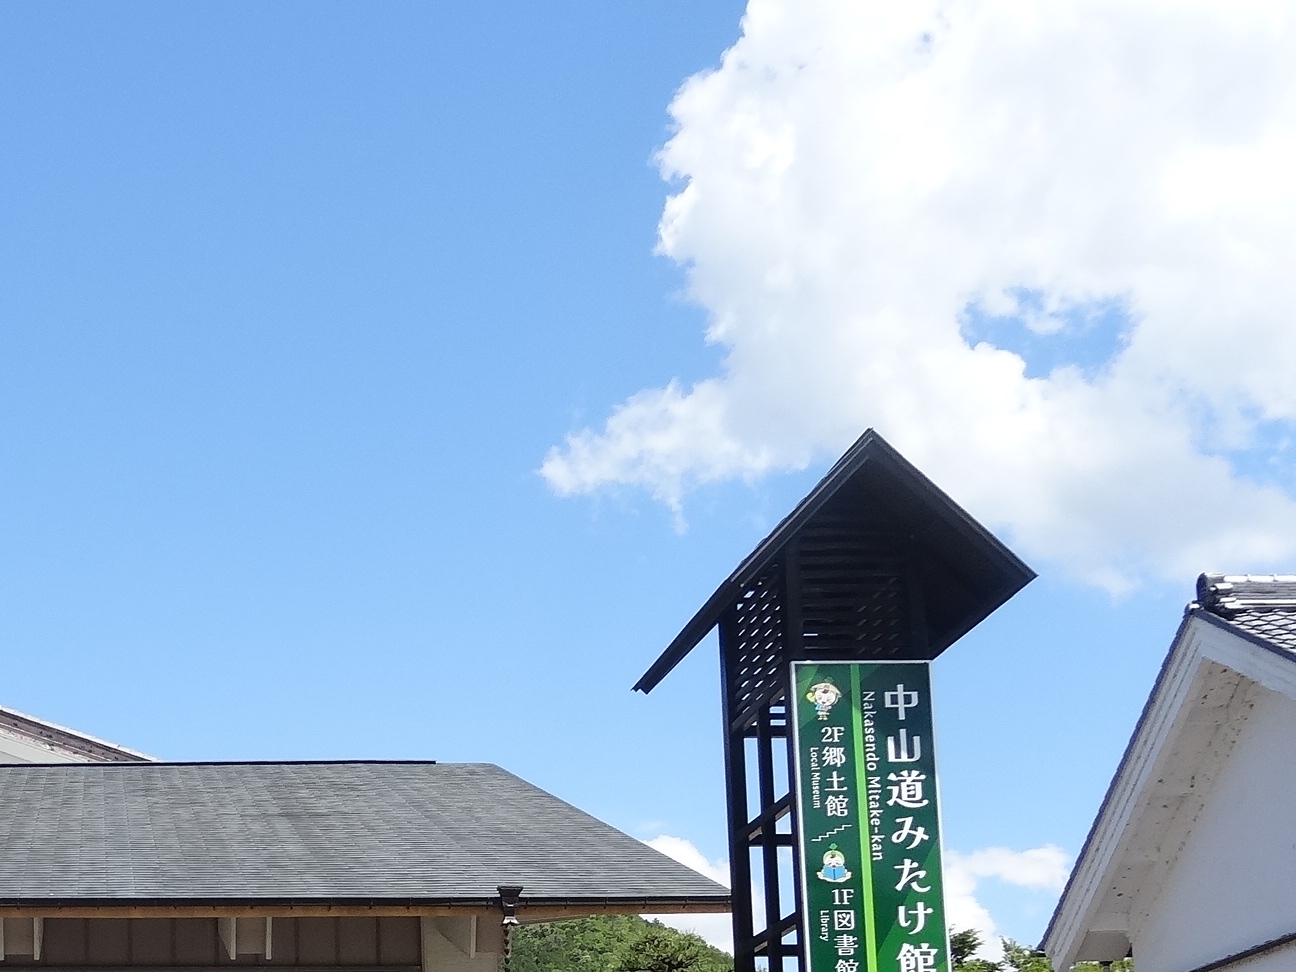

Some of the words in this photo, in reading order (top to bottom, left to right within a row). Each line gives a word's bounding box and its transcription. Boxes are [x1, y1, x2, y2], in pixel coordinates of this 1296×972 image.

[810, 747, 820, 771] Local
[862, 690, 877, 771] Nakasendo
[811, 772, 821, 809] Museum
[821, 726, 849, 817] 2F郷土館
[867, 776, 883, 861] Mitake-kan
[819, 909, 830, 942] Library
